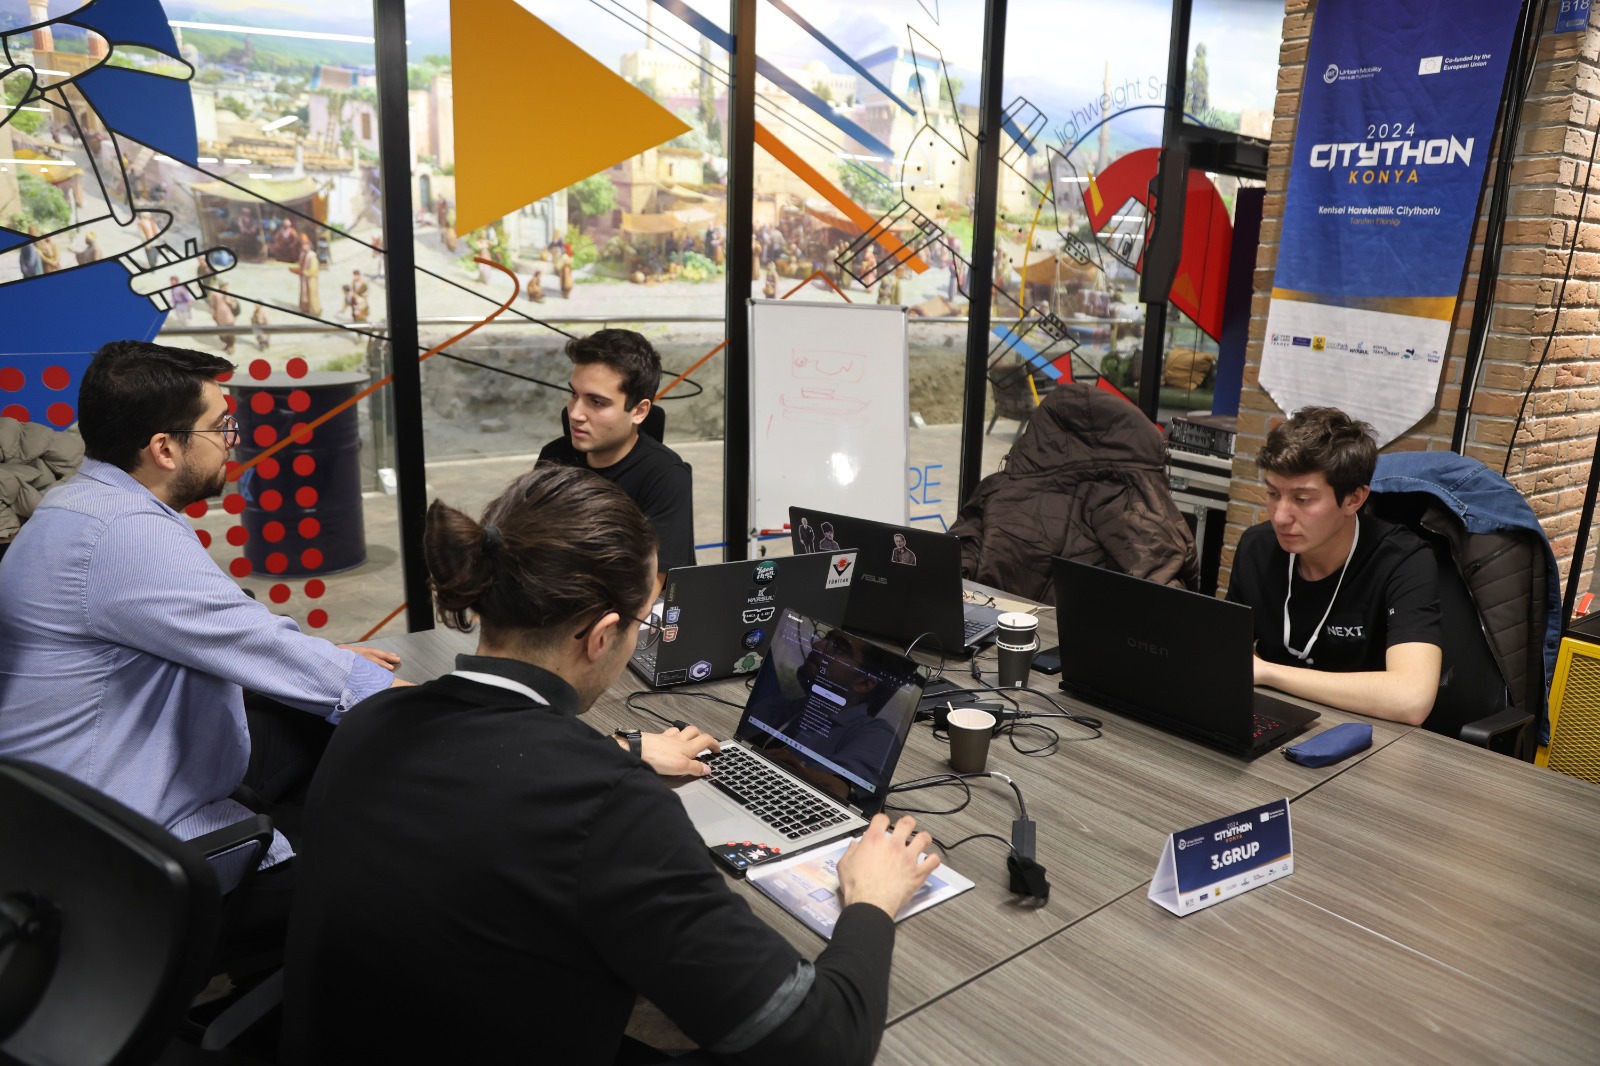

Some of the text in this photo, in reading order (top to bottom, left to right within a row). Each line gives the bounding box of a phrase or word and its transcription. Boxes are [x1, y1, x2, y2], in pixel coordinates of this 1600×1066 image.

[1443, 63, 1469, 71] European
[1444, 55, 1473, 63] Co-funded
[1366, 122, 1416, 139] 2024
[1309, 134, 1475, 172] CITYTHON
[1348, 168, 1419, 185] KONYA
[1318, 205, 1441, 217] Kentsel Hareketlilik Citython'u
[1326, 625, 1364, 637] NEXT
[1213, 822, 1253, 842] CITYTHON
[1210, 841, 1261, 870] 3.GRUP
